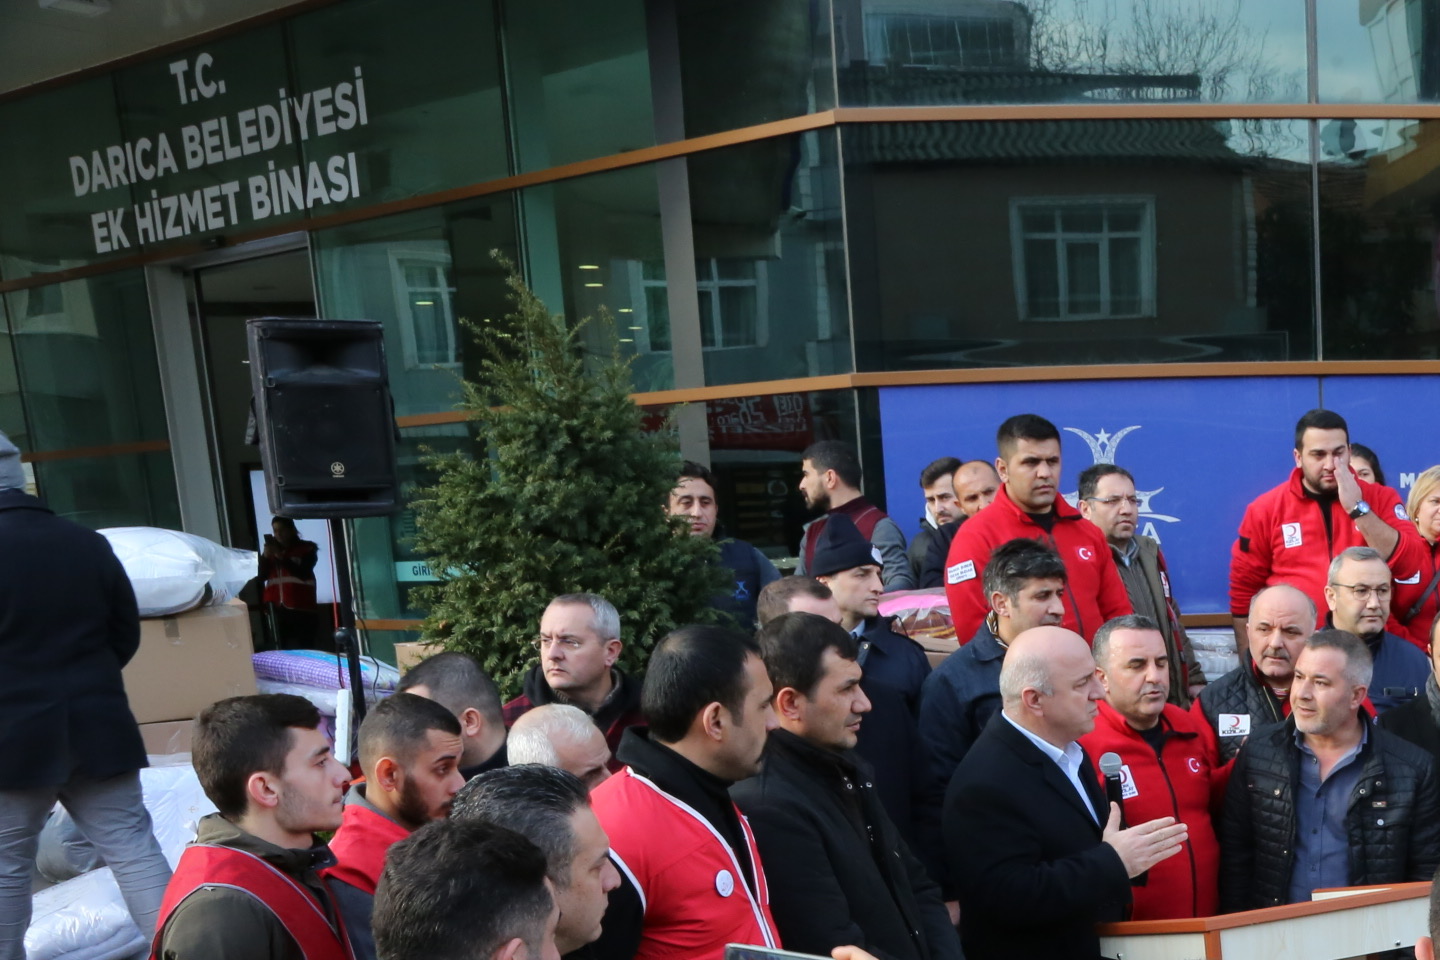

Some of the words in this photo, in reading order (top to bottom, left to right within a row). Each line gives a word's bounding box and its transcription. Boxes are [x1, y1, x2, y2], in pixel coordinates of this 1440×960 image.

[169, 53, 226, 104] T.C.
[69, 133, 178, 197] DARICA
[182, 66, 368, 170] BELEDİYESİ
[91, 208, 130, 254] EK
[134, 181, 240, 244] HİZMET
[248, 152, 360, 220] BİNASI
